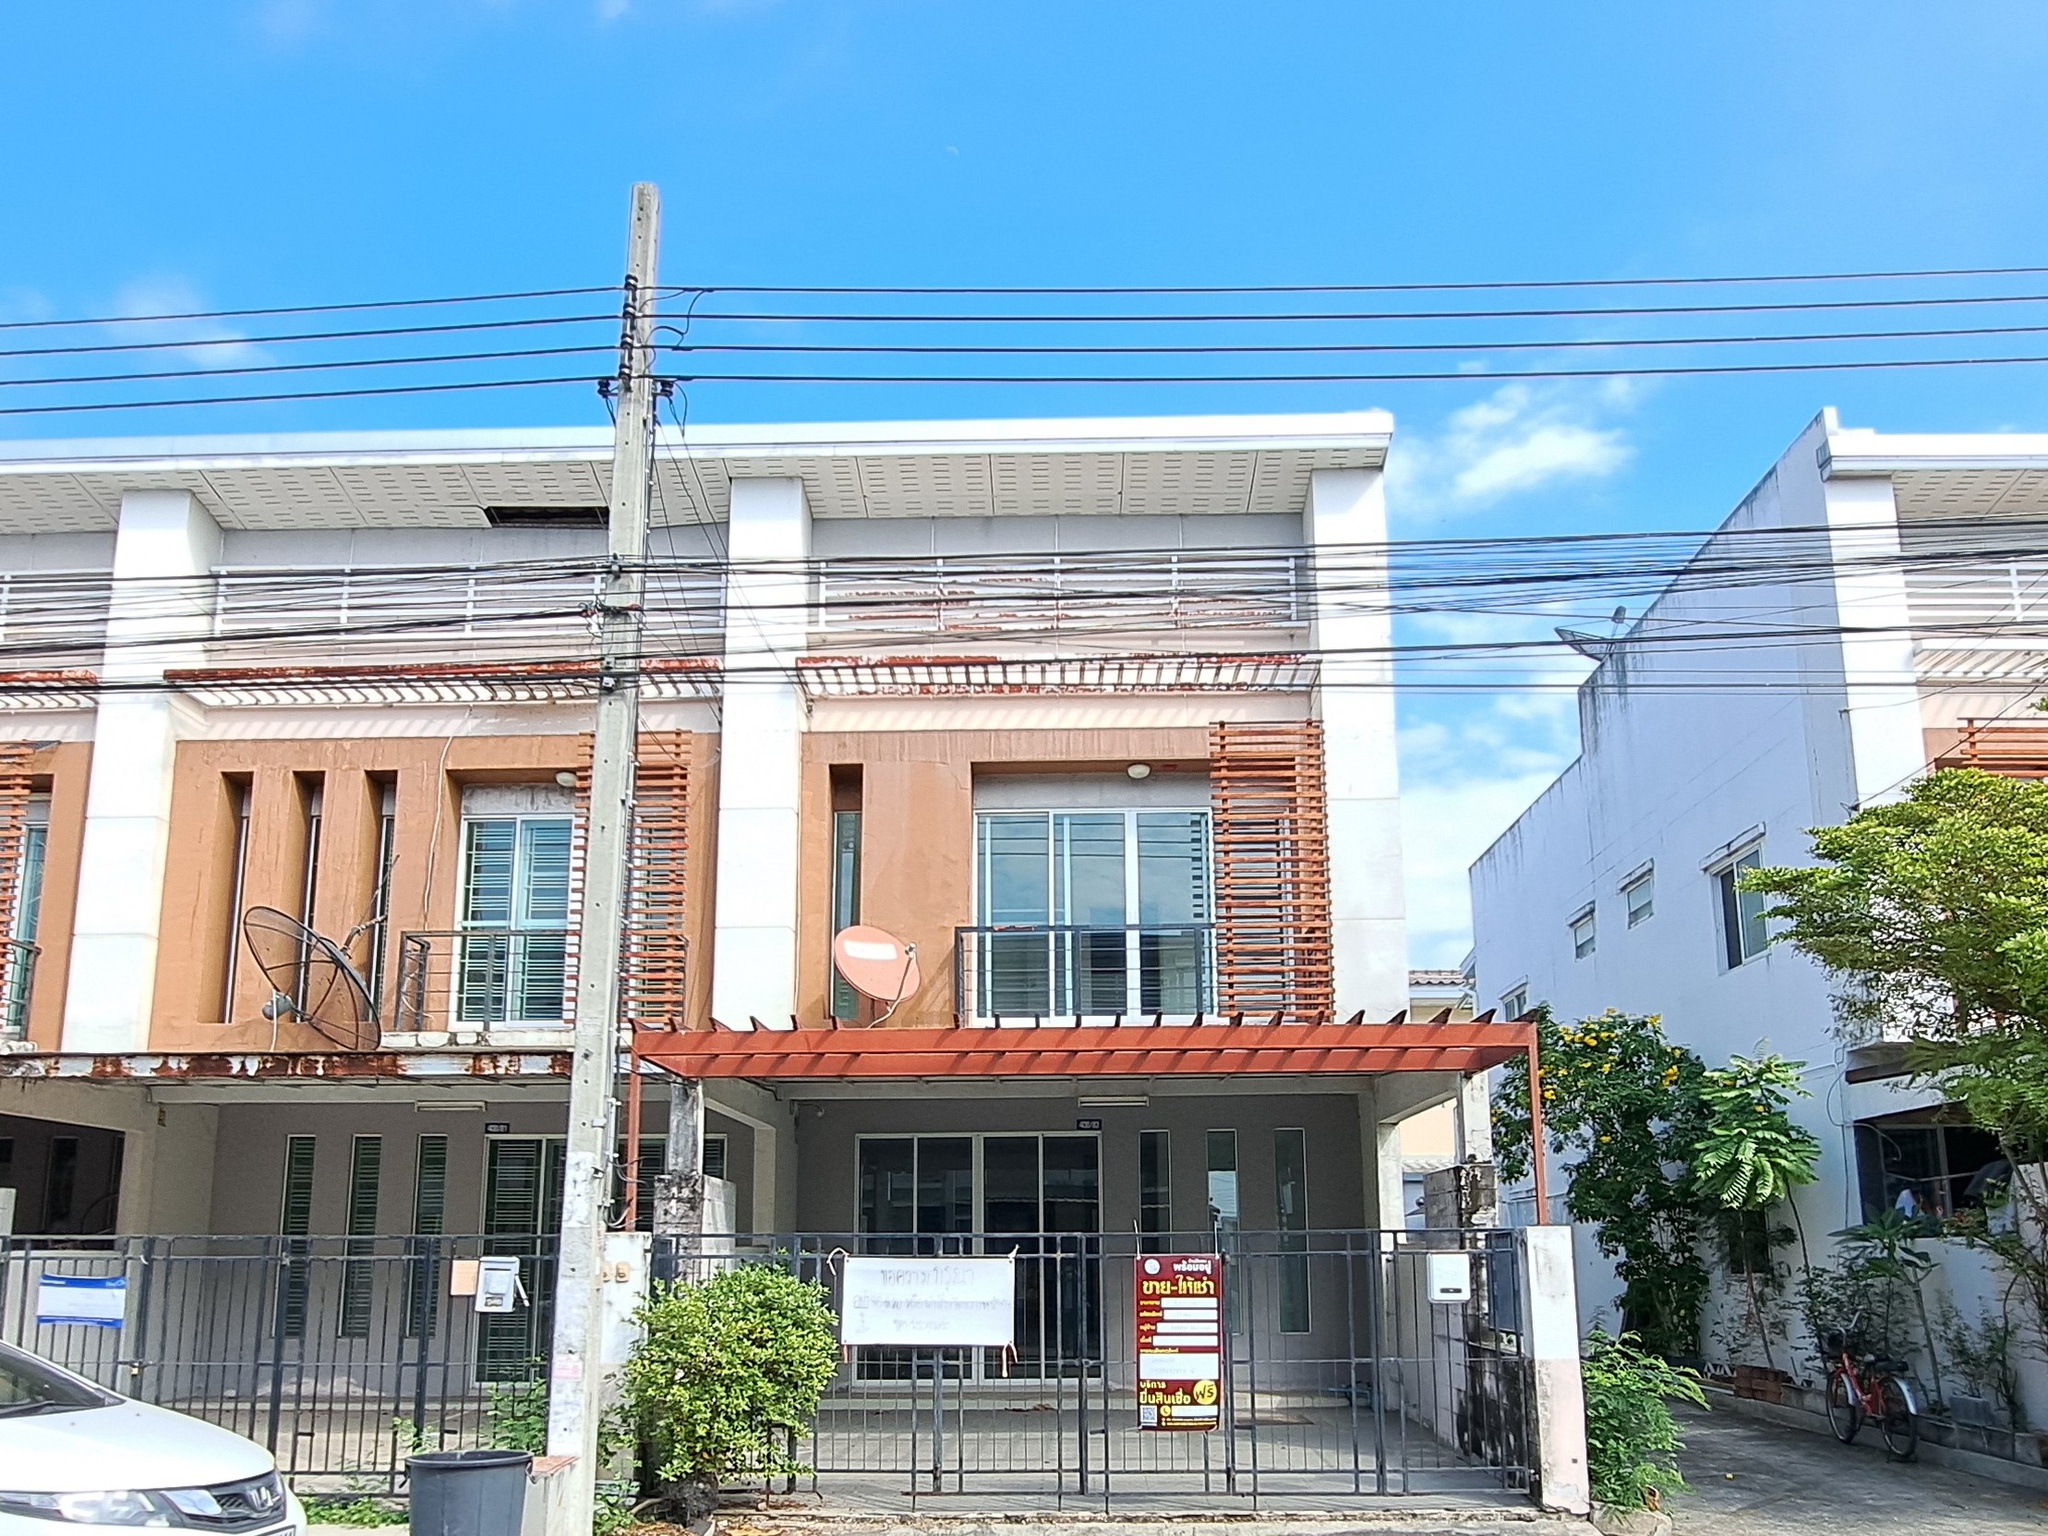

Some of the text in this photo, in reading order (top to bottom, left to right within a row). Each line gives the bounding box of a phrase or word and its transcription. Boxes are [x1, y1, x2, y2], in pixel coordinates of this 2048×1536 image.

[1142, 1274, 1215, 1295] ขาย-ให้เช่า
[1195, 1384, 1215, 1401] ฟรี
